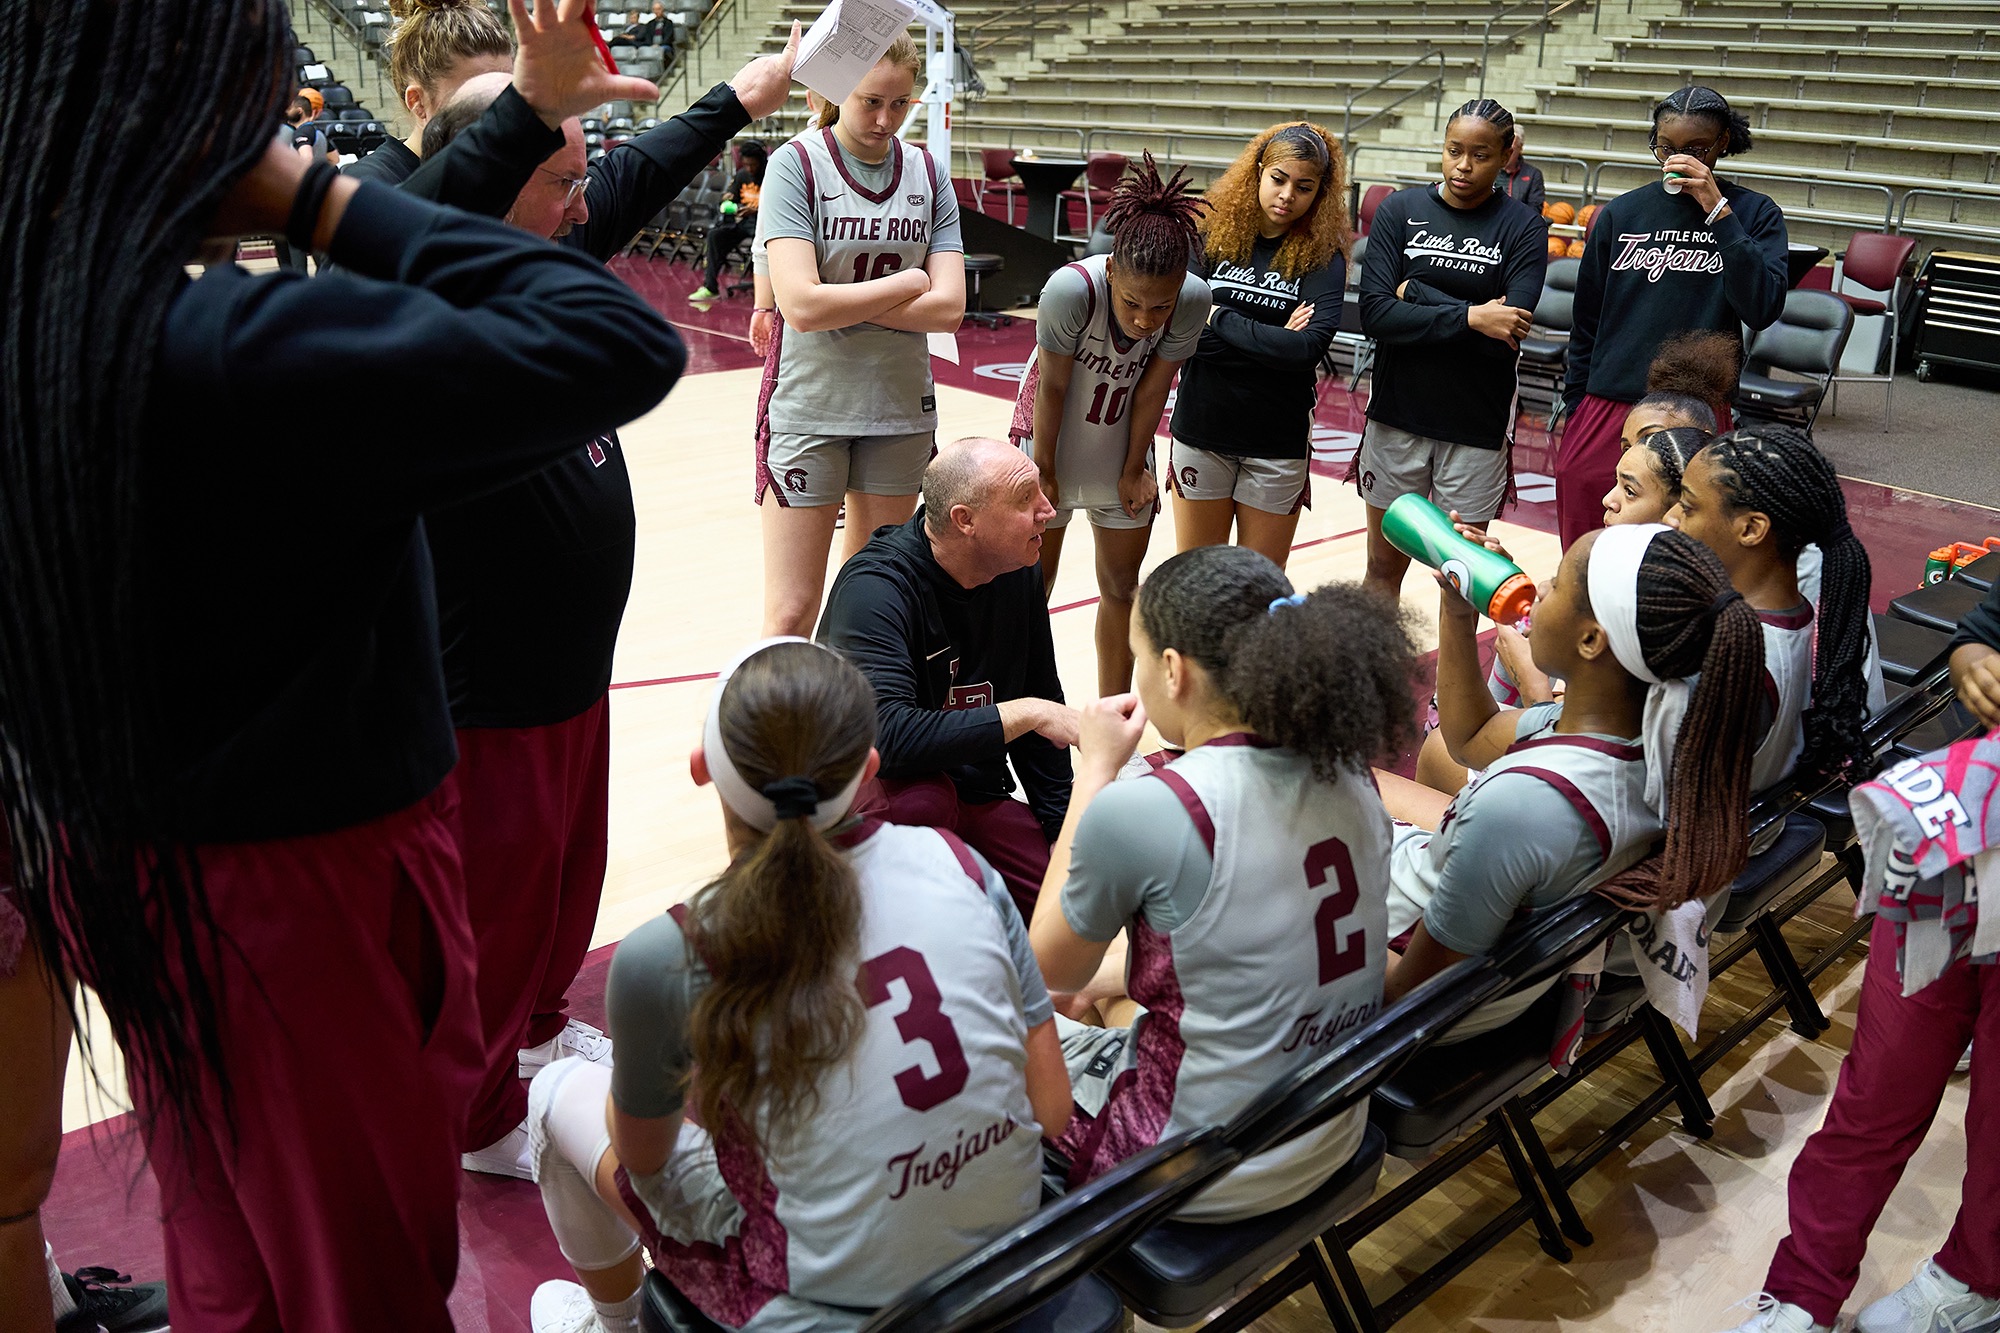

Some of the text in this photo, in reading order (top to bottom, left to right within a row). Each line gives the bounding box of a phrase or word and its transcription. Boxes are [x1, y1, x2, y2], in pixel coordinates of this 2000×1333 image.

[822, 216, 928, 244] LITTLE ROCK
[1407, 230, 1501, 260] Little Rock
[1654, 230, 1691, 242] LITTLE
[1429, 256, 1486, 275] TROJANS
[1611, 233, 1724, 283] Trojans
[1211, 260, 1301, 296] Little Rock
[1230, 289, 1287, 311] TROJANS
[1074, 348, 1125, 381] LITTLE
[1085, 382, 1131, 426] 10
[1303, 836, 1366, 988] 2
[854, 944, 971, 1114] 3
[1282, 995, 1379, 1053] Trojans
[887, 1111, 1019, 1201] Trojans
